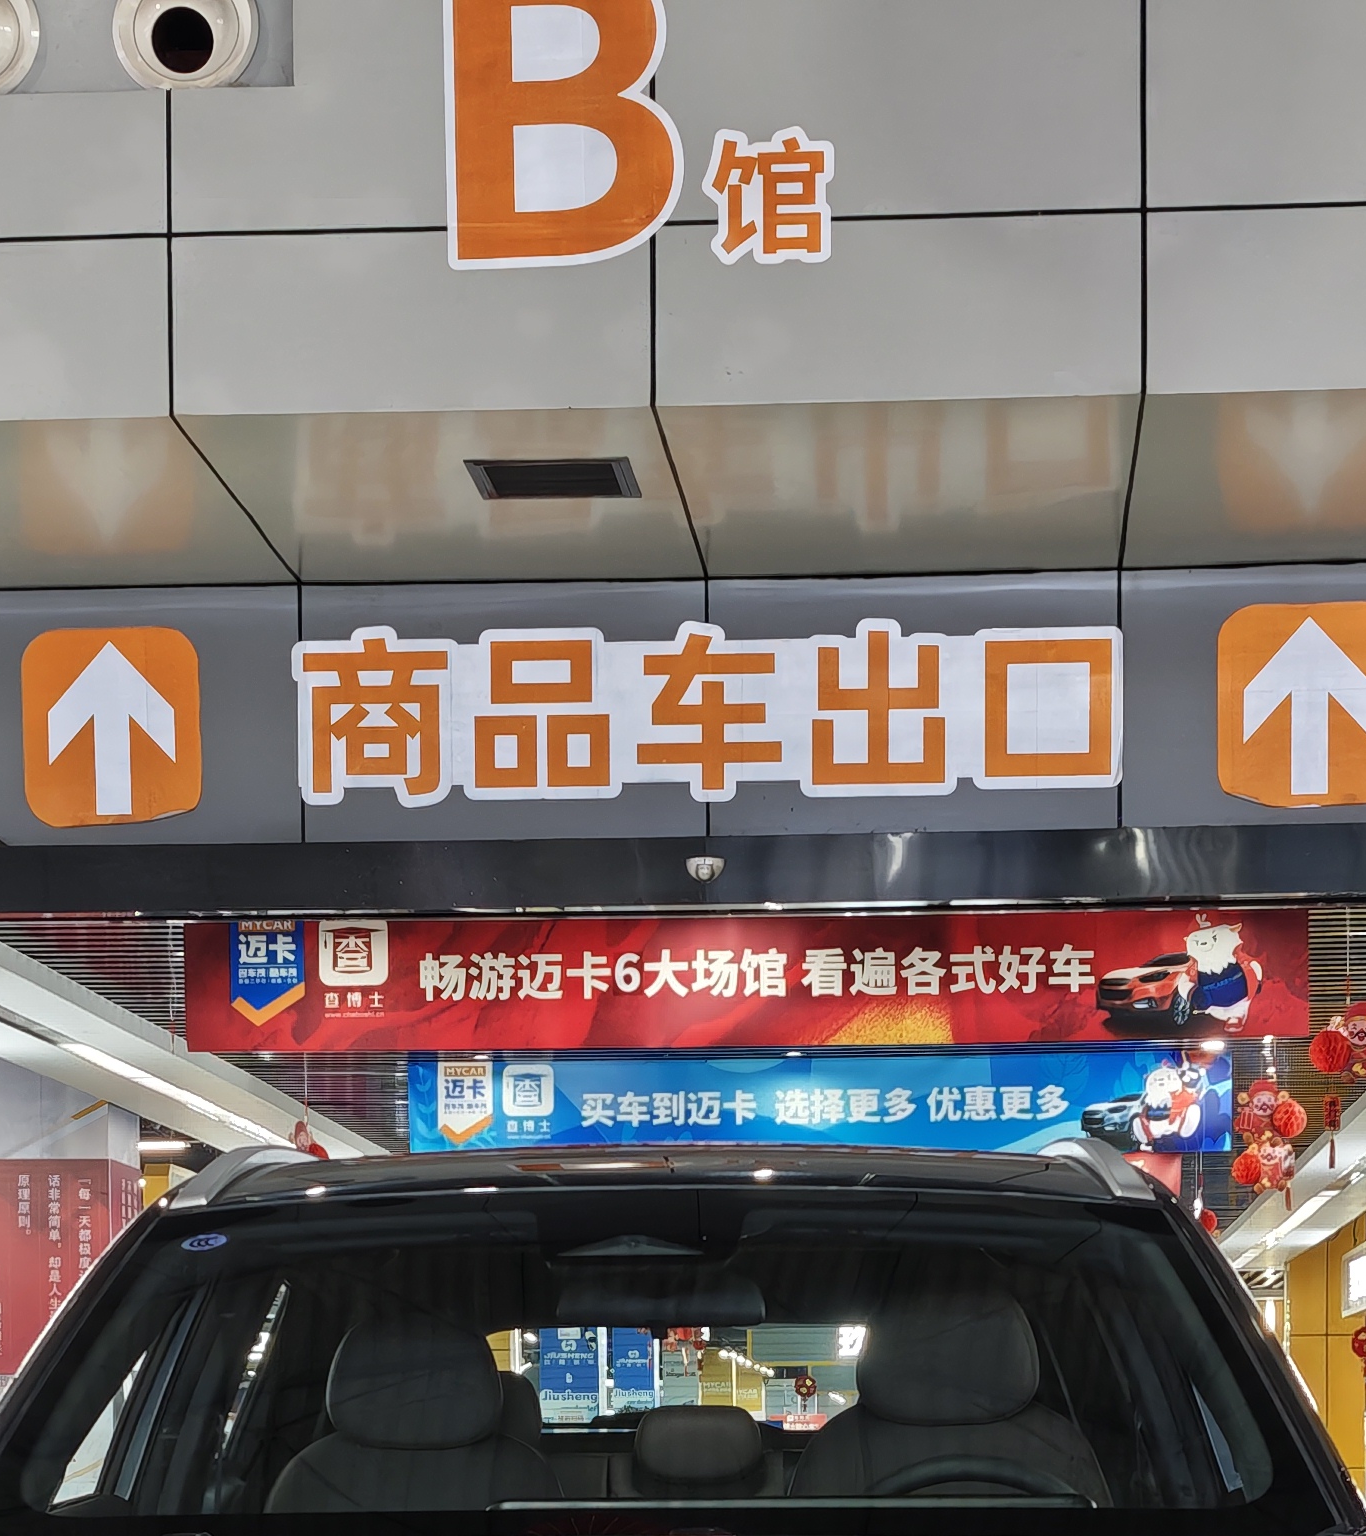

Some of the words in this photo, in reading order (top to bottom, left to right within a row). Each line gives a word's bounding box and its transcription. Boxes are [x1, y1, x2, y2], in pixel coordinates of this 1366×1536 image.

[300, 628, 1115, 797] 商品车出口
[240, 920, 294, 931] MYCAR
[238, 934, 297, 965] 迈卡
[419, 947, 786, 1002] 畅游迈卡6大场馆
[801, 944, 1096, 997] 看遍各式好车
[324, 991, 384, 1009] 查博士
[445, 1067, 485, 1076] MYCAR
[444, 1078, 487, 1100] 迈卡
[581, 1089, 757, 1128] 买车到迈卡
[775, 1087, 917, 1126] 选择更多
[926, 1084, 1070, 1123] 优惠更多
[506, 1119, 551, 1133] 查博士
[542, 1390, 598, 1404] Jiusheng
[615, 1389, 654, 1402] Jiusheng
